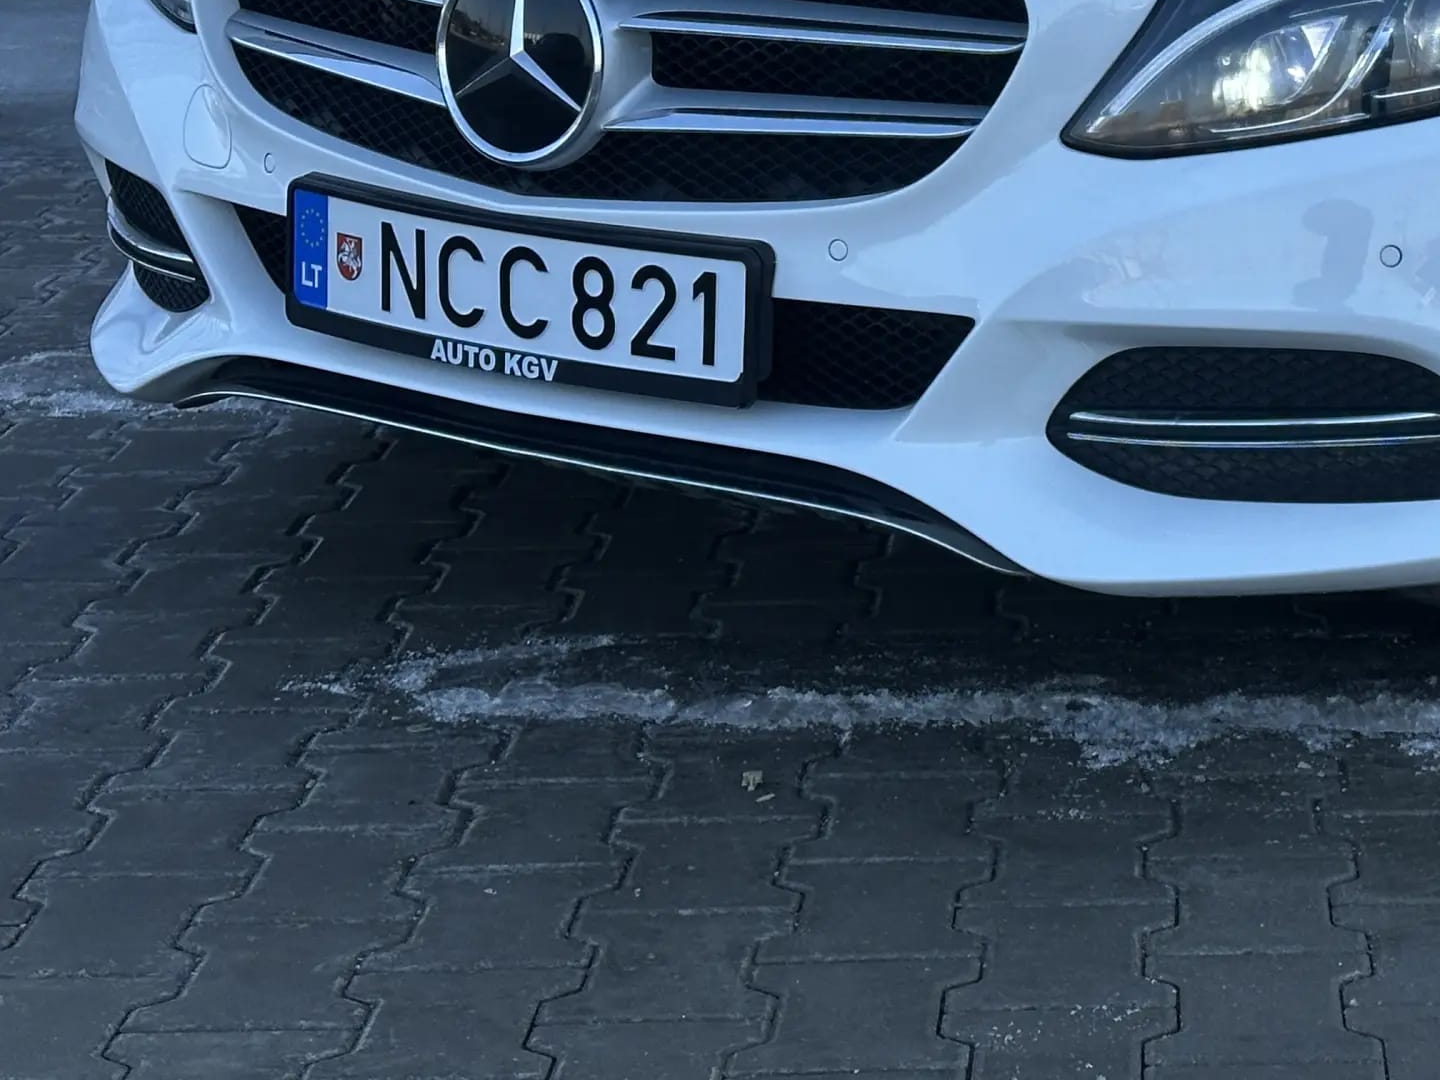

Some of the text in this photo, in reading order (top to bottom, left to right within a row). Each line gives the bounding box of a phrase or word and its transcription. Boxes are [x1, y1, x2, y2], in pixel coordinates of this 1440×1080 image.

[301, 261, 322, 288] LT
[431, 339, 558, 381] AUTO KGV
